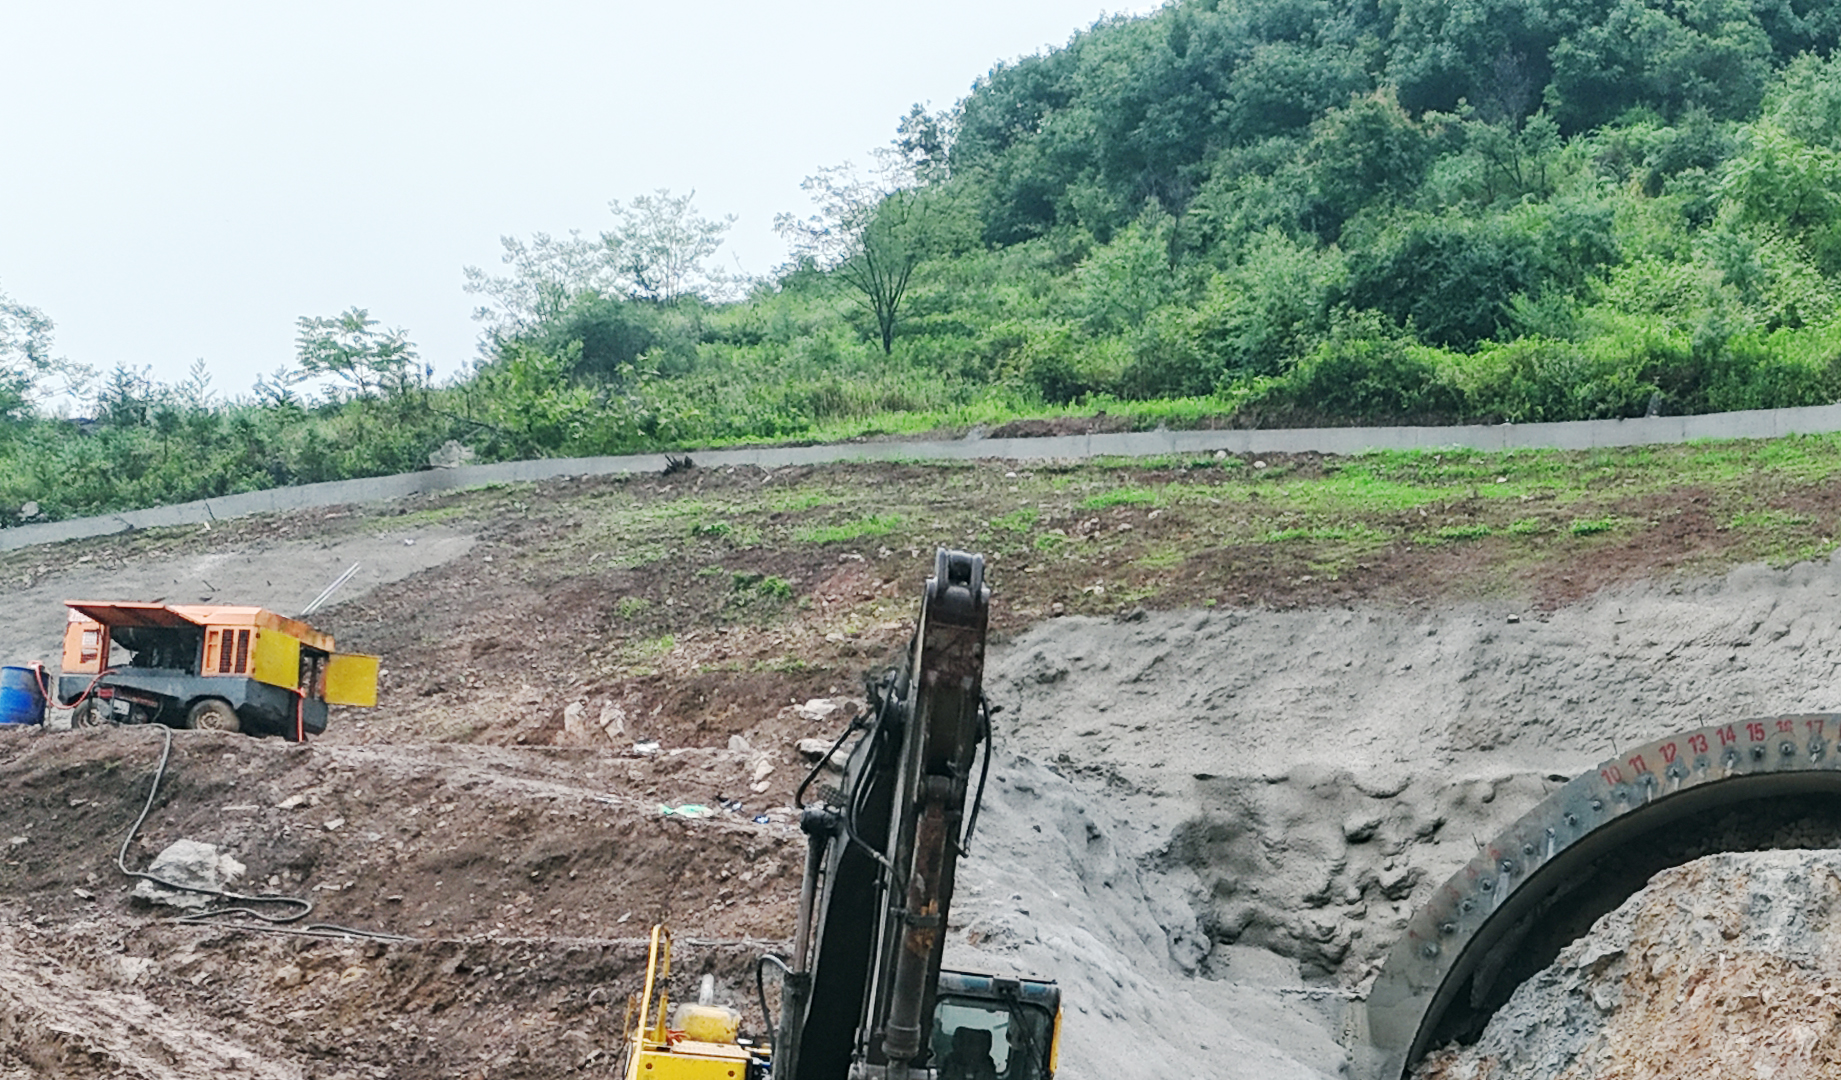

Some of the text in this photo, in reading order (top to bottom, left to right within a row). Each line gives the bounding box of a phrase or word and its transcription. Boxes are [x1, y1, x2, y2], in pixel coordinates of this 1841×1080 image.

[1601, 765, 1622, 786] 10
[1629, 755, 1648, 774] 11
[1659, 743, 1678, 763] 12
[1688, 734, 1709, 754] 13
[1716, 725, 1737, 746] 14
[1745, 723, 1766, 742] 15
[1805, 719, 1824, 735] 17
